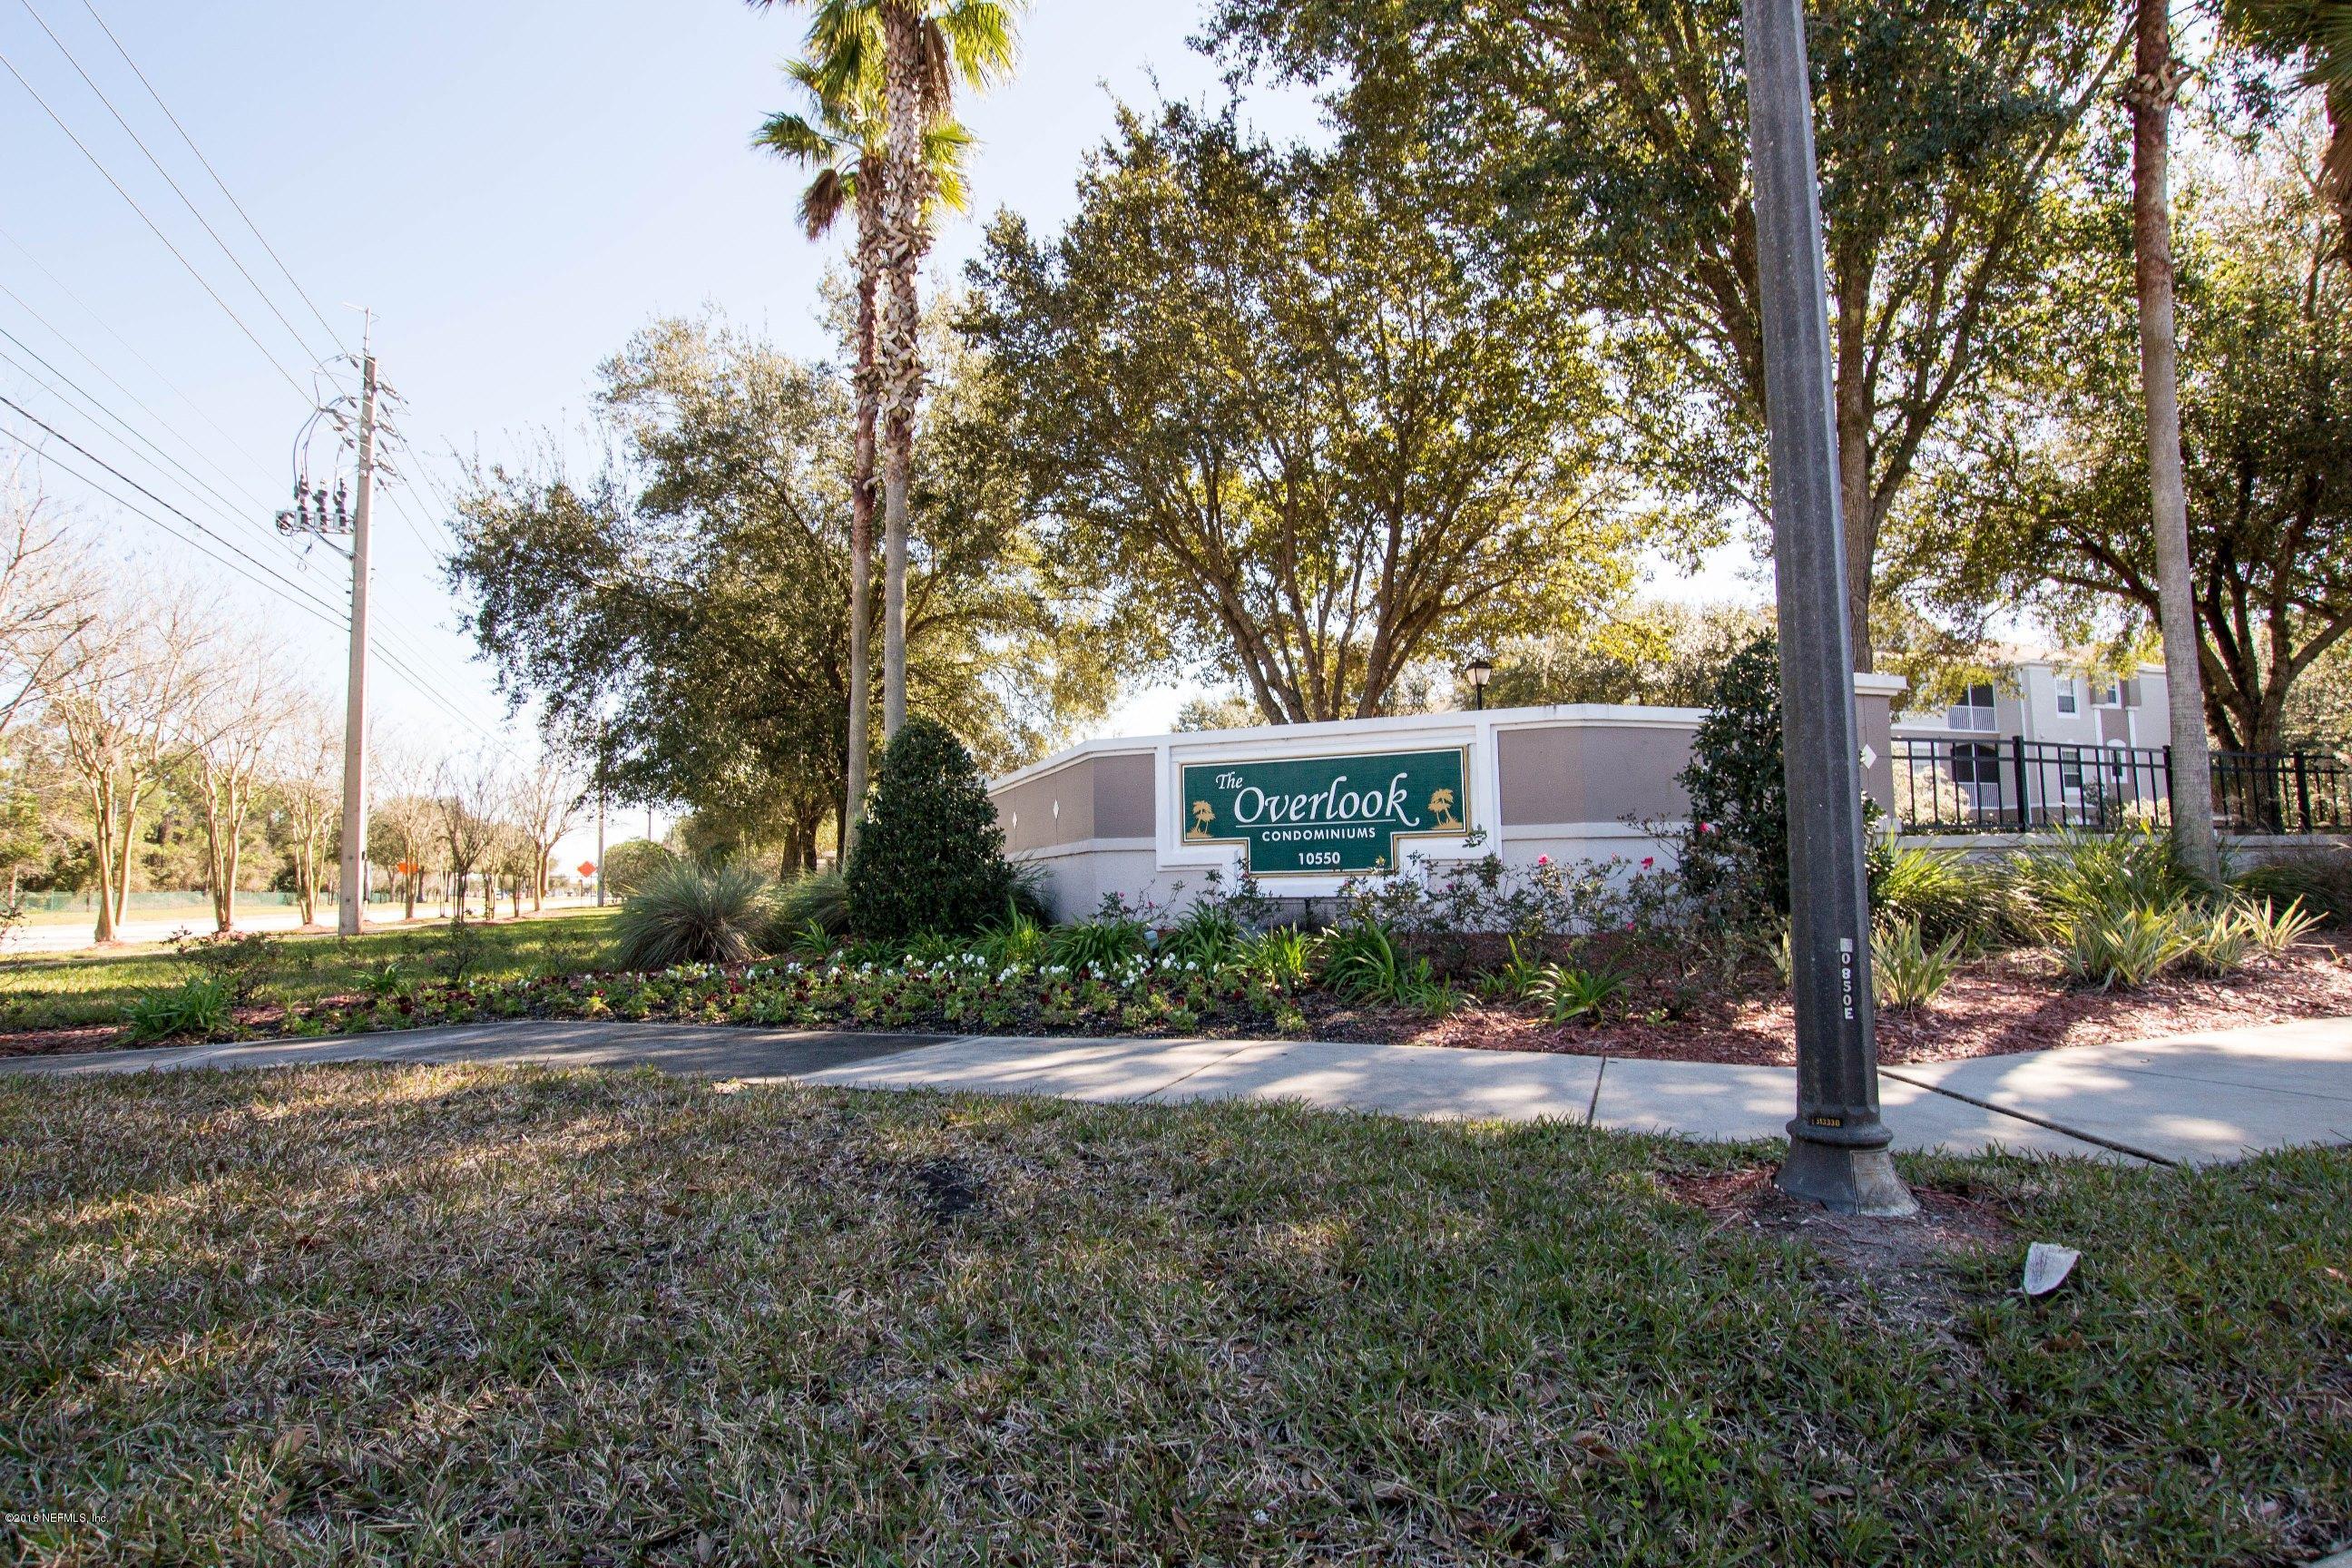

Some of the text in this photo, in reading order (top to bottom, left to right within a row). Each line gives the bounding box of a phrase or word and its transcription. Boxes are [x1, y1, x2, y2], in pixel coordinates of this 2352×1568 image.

[1216, 771, 1242, 790] The
[1234, 772, 1420, 827] Overlook
[1262, 828, 1376, 842] CONDOMINIUMS
[1298, 852, 1341, 866] 10550
